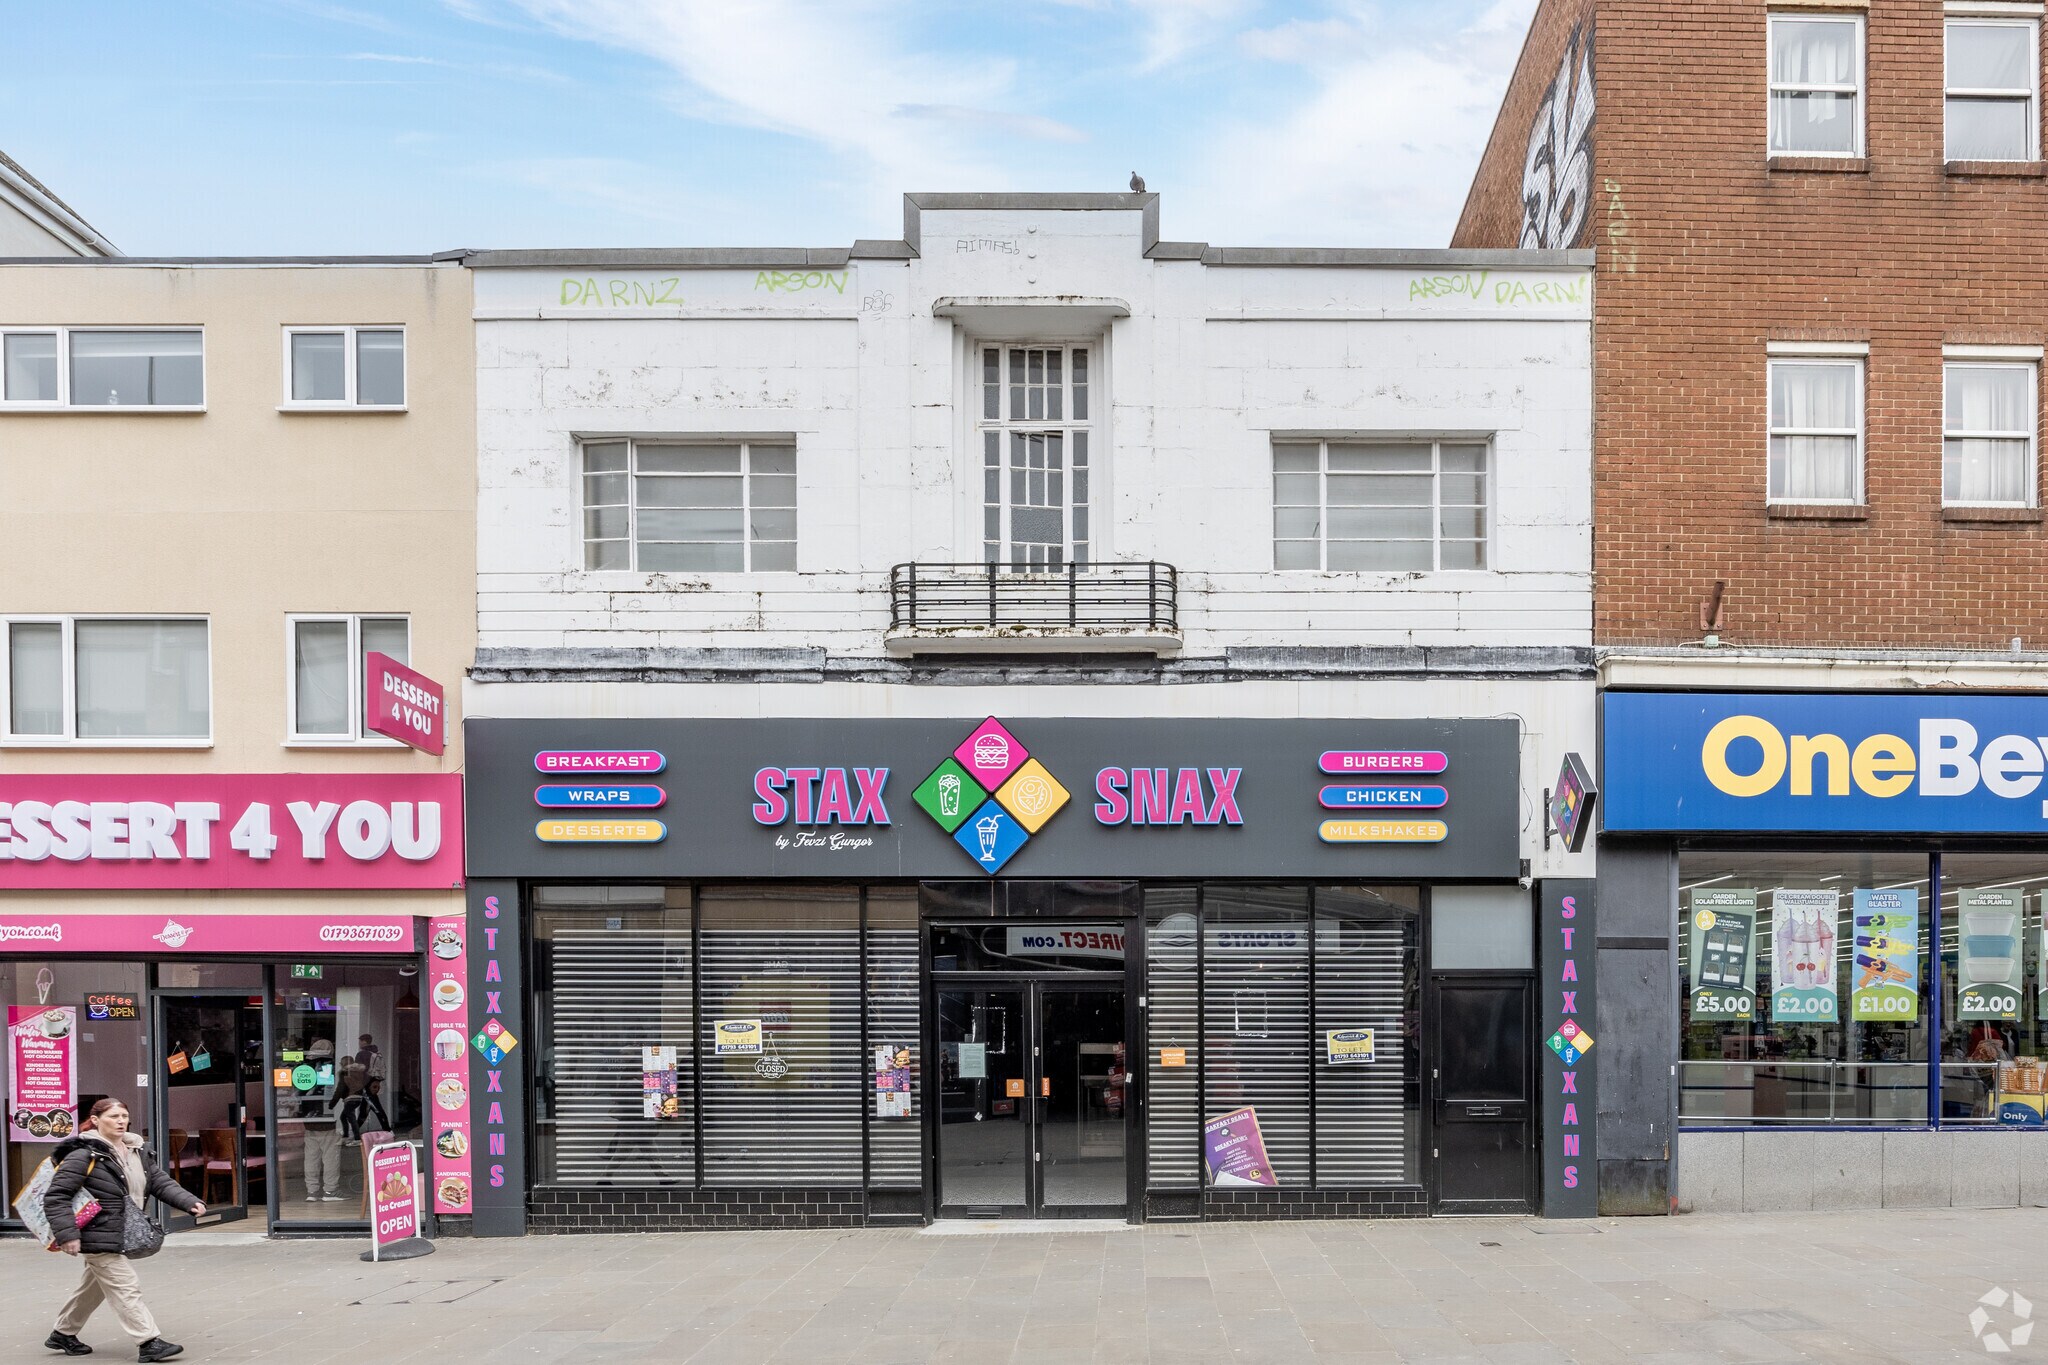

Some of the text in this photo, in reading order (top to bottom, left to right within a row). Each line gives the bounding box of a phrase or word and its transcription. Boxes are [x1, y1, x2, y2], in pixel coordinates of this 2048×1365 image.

[754, 270, 848, 295] ARSON
[1409, 271, 1487, 302] ARSON
[383, 671, 439, 715] DESSERT
[391, 702, 432, 735] 4 YOU
[546, 756, 651, 768] BREAKFAST
[1343, 755, 1424, 768] BURGERS
[1702, 715, 2048, 798] OneBe
[568, 790, 631, 802] WRAPS
[752, 766, 892, 826] STAX
[1094, 766, 1244, 827] SNAX
[1345, 789, 1423, 803] CHICKEN
[229, 801, 278, 860] 4
[286, 800, 441, 861] YOU
[552, 824, 647, 837] DESSERTS
[1329, 824, 1439, 837] MILKSHAKES
[775, 831, 874, 851] by Fevzi Gungor
[0, 925, 60, 940] you.co.uk
[322, 928, 401, 939] 01793671039
[484, 896, 502, 1014] STAX
[1561, 896, 1578, 1014] STAX
[89, 995, 132, 1005] Coffee
[1696, 996, 1751, 1013] £5.00
[1777, 997, 1833, 1014] £2.00
[1859, 996, 1910, 1013] £1.00
[1962, 996, 2016, 1012] £2.00
[109, 1007, 135, 1017] OPEN
[757, 1065, 786, 1073] CLOSED
[2003, 1112, 2028, 1121] Only
[375, 1157, 395, 1168] DESSERT
[399, 1154, 410, 1162] YOU
[378, 1199, 412, 1213] Ice Cream
[380, 1214, 412, 1235] OPEN
